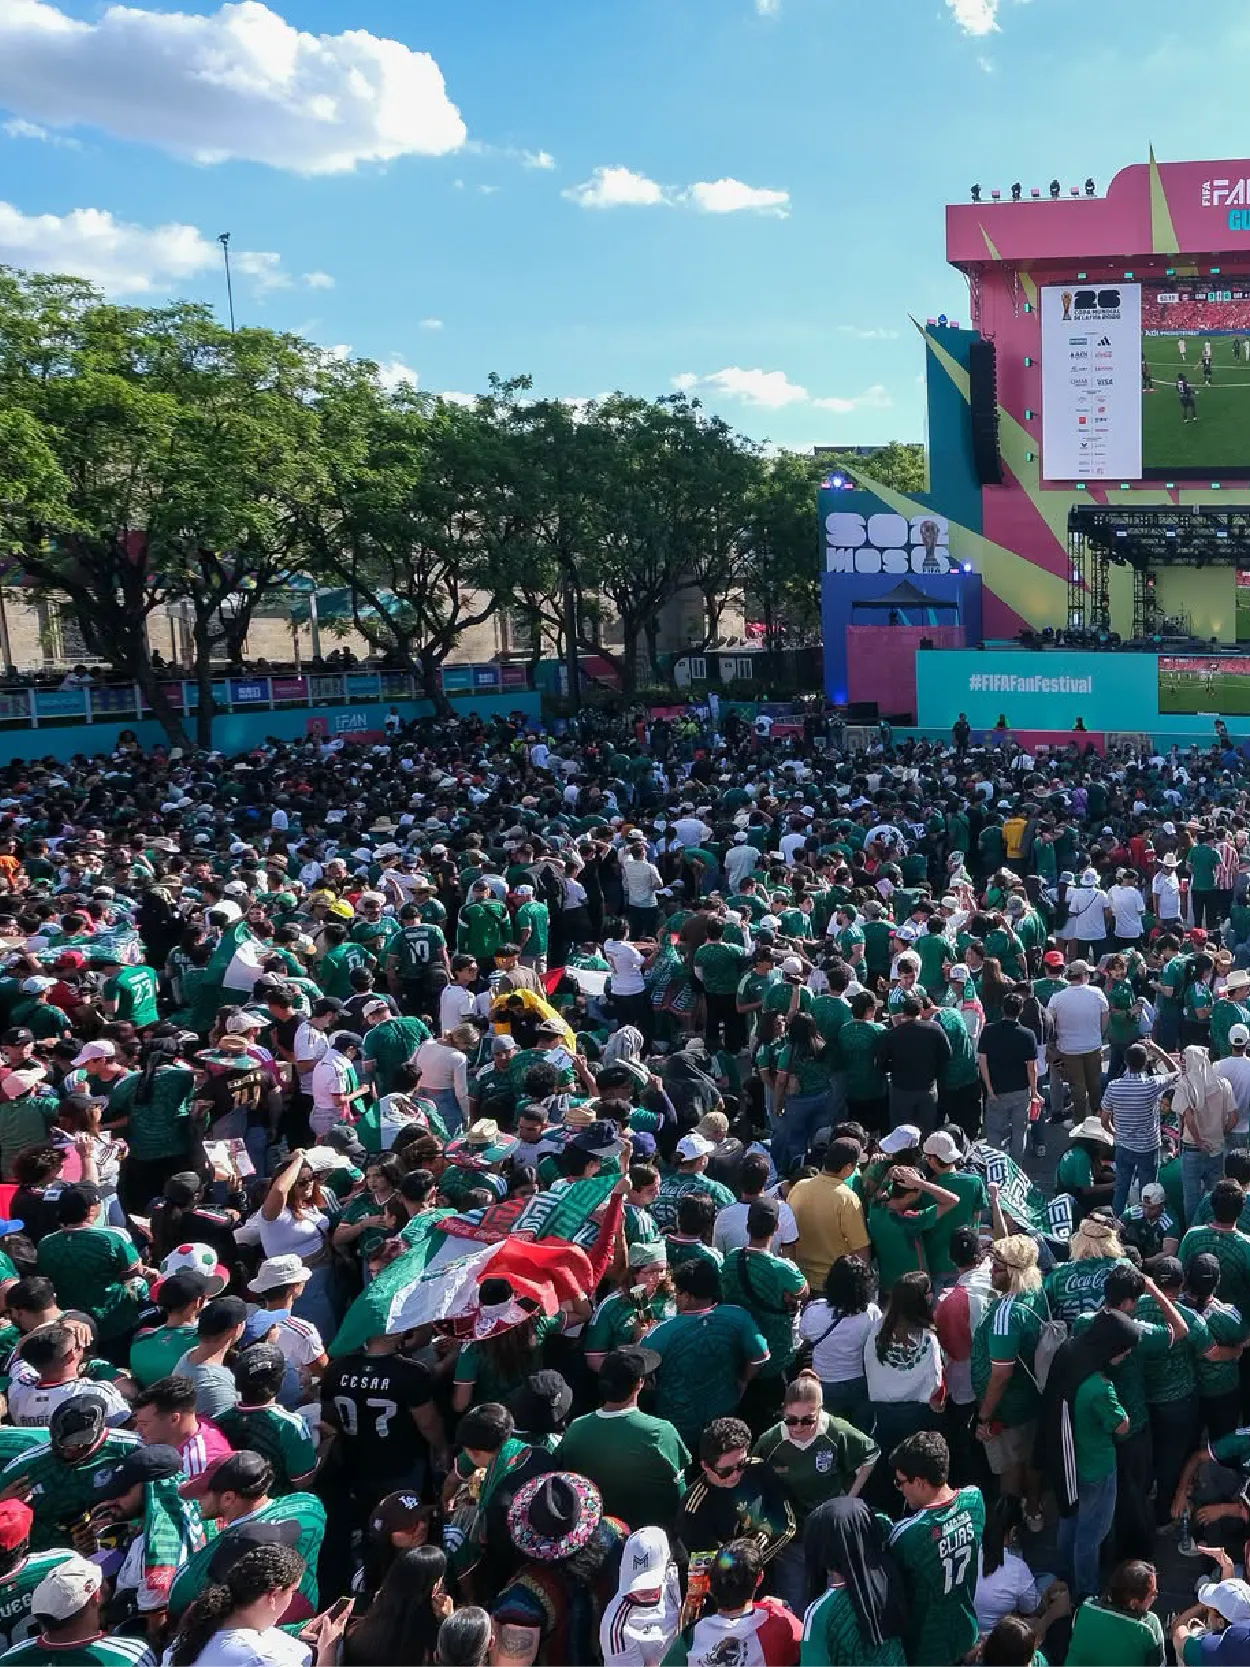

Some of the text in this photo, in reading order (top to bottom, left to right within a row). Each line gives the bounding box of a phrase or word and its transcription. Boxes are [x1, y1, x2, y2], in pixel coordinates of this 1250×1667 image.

[1202, 180, 1210, 206] FIFA
[969, 673, 1092, 693] #FIFAFanFestival
[334, 1396, 398, 1436] 07
[938, 1521, 975, 1559] ELIAS
[941, 1546, 972, 1596] 17
